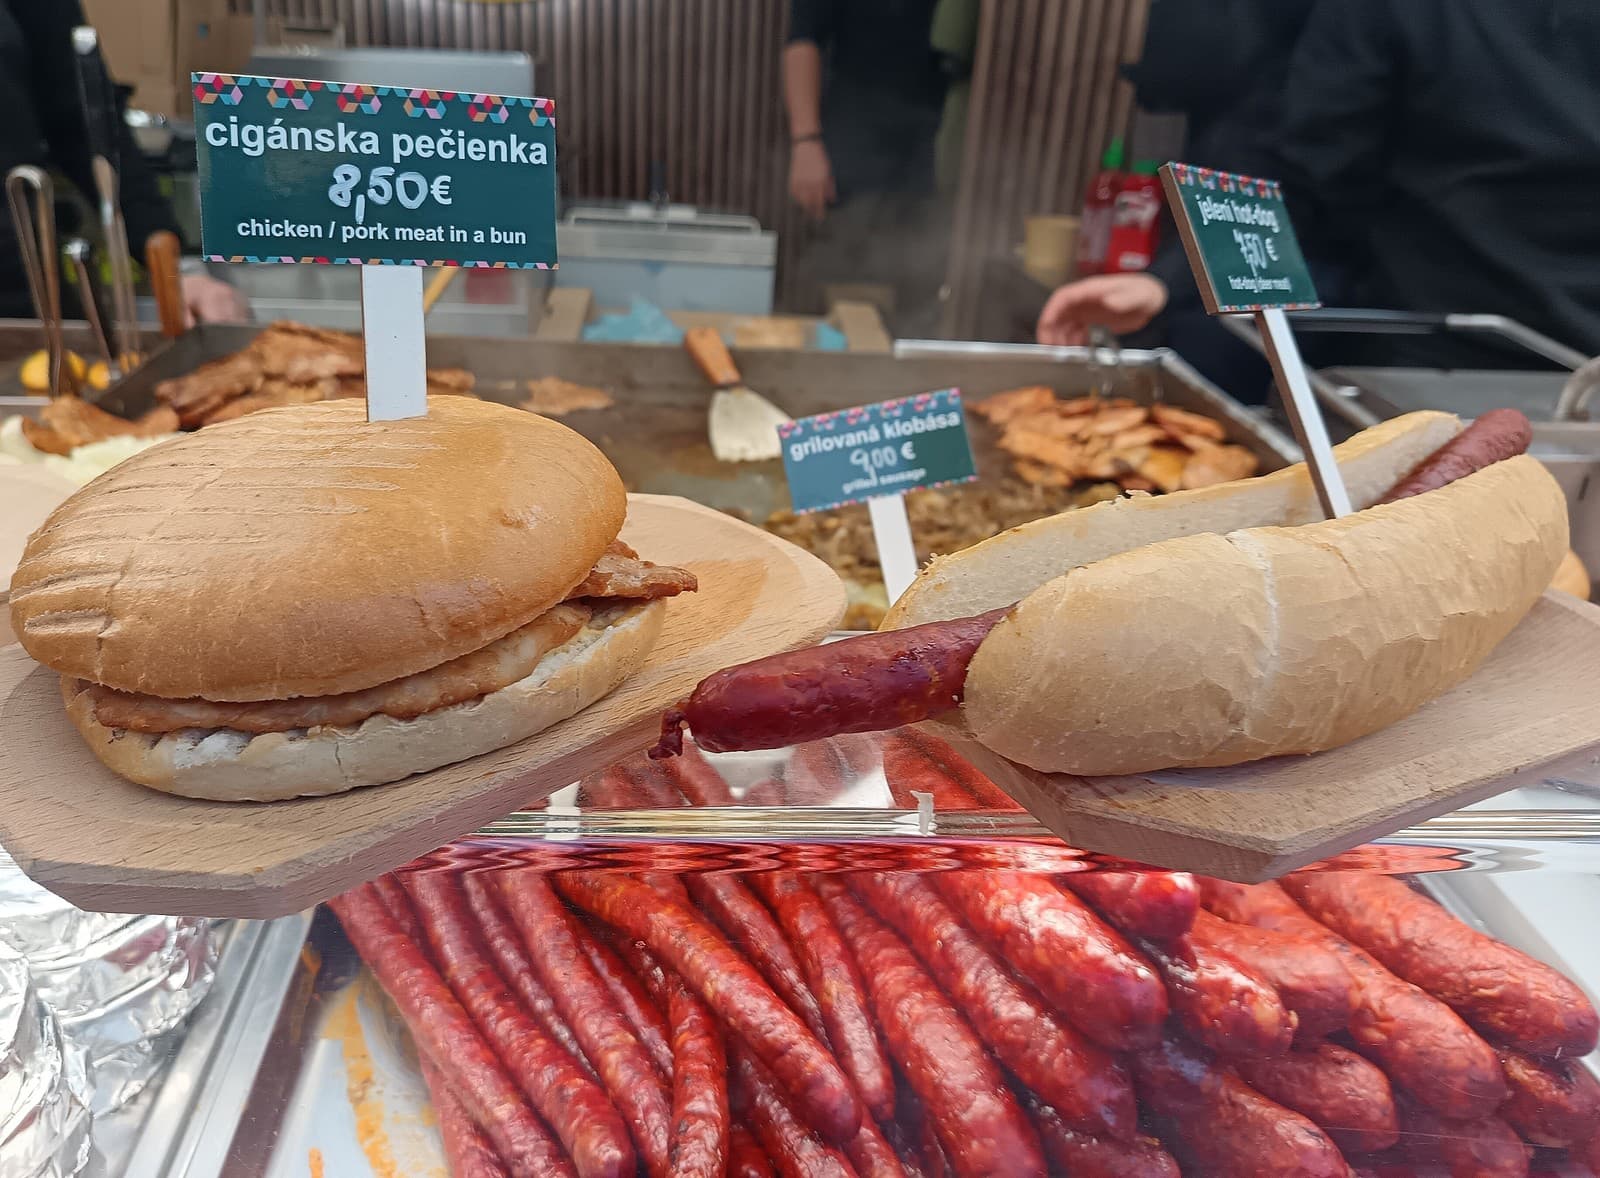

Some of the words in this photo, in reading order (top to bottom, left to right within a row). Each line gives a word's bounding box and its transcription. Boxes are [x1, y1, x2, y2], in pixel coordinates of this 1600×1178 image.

[205, 116, 380, 157] cigánska
[392, 129, 548, 165] pečienka
[237, 219, 323, 238] chicken
[329, 222, 336, 239] /
[342, 222, 389, 243] pork
[395, 225, 444, 242] meat
[450, 225, 468, 242] in
[473, 230, 485, 243] a
[490, 227, 527, 245] bun
[790, 424, 880, 461] grilovaná
[883, 412, 960, 439] klobása
[901, 441, 916, 460] €
